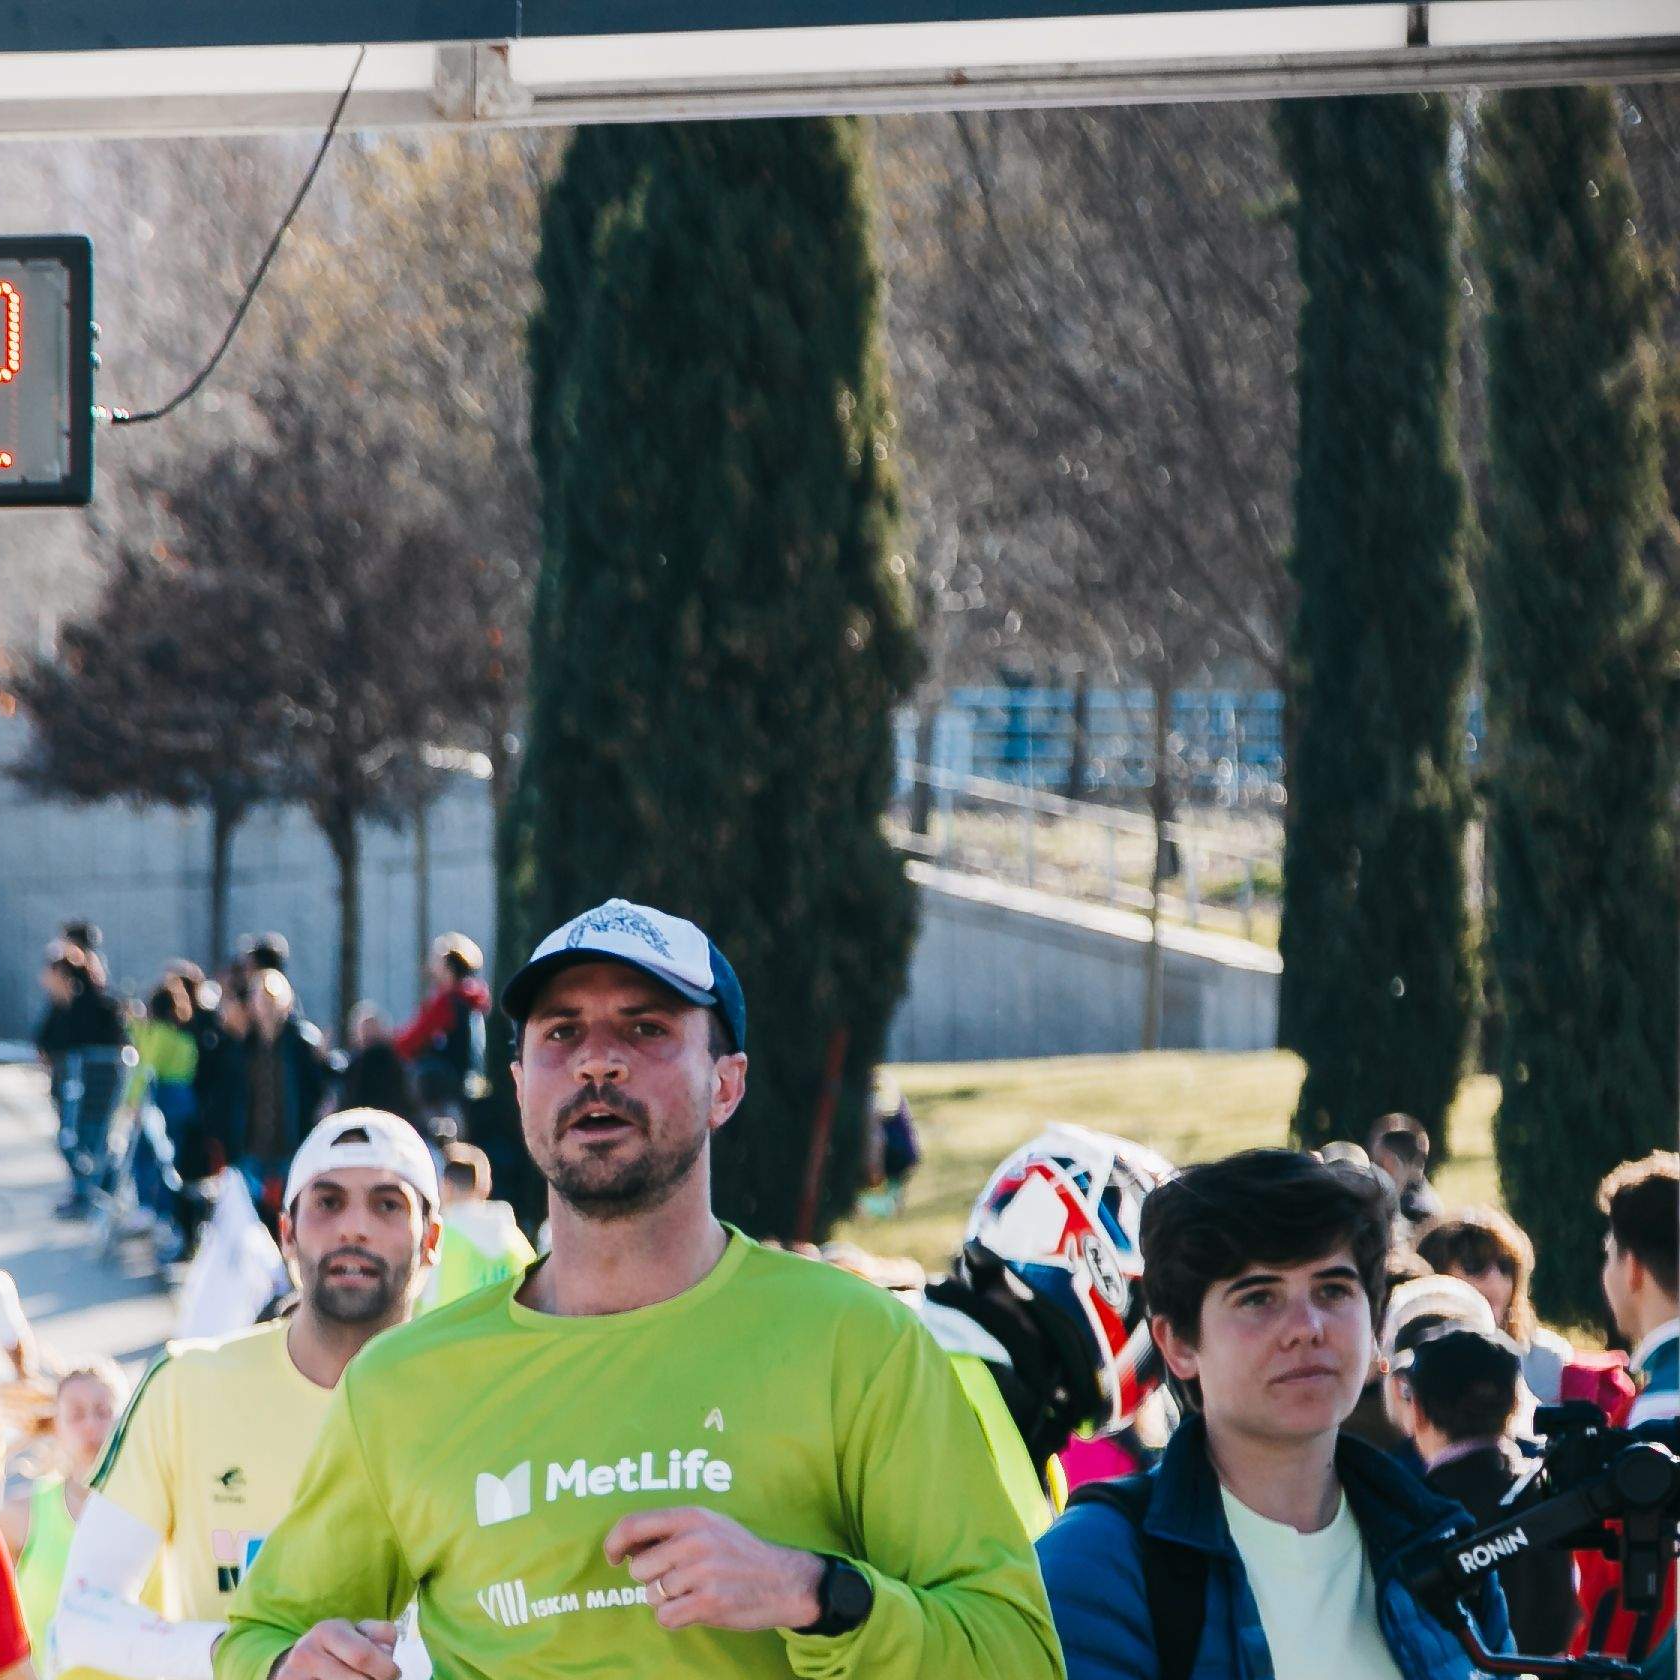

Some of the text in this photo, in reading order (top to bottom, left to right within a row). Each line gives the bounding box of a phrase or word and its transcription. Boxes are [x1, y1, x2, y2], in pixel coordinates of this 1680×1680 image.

[545, 1448, 733, 1502] MetLife
[1457, 1526, 1530, 1574] RONIN
[476, 1577, 529, 1628] VIII
[585, 1584, 649, 1610] MADR
